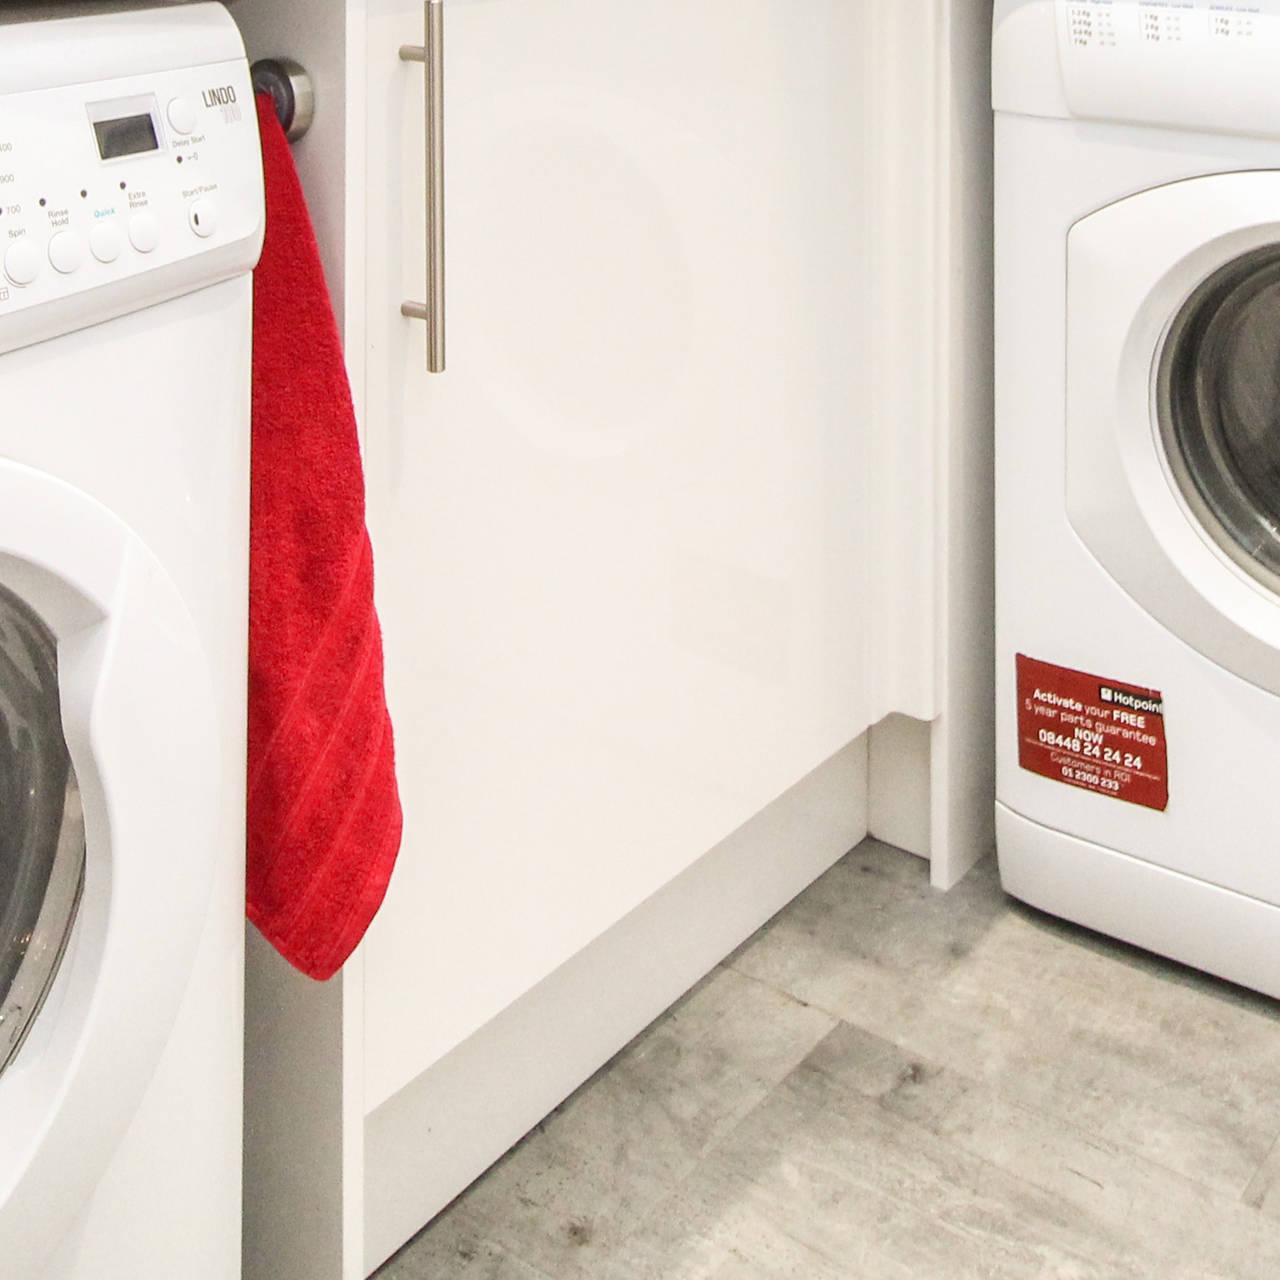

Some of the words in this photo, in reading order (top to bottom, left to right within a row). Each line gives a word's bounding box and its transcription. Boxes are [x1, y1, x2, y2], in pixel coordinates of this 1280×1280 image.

[202, 85, 237, 108] LINDO
[0, 174, 15, 184] 900
[128, 190, 146, 201] Extra
[6, 205, 21, 215] 700
[8, 228, 26, 238] Spin
[1033, 688, 1083, 712] Activate
[1084, 704, 1111, 719] your
[1113, 709, 1146, 729] FREE
[1034, 703, 1058, 718] year
[1060, 711, 1093, 729] parts
[1095, 721, 1157, 747] guarantee
[1074, 727, 1104, 746] NOW
[1038, 728, 1081, 752] 08448
[1083, 741, 1101, 758] 24
[1103, 747, 1121, 764] 24
[1123, 753, 1142, 770] 24
[1050, 751, 1102, 775] Customers
